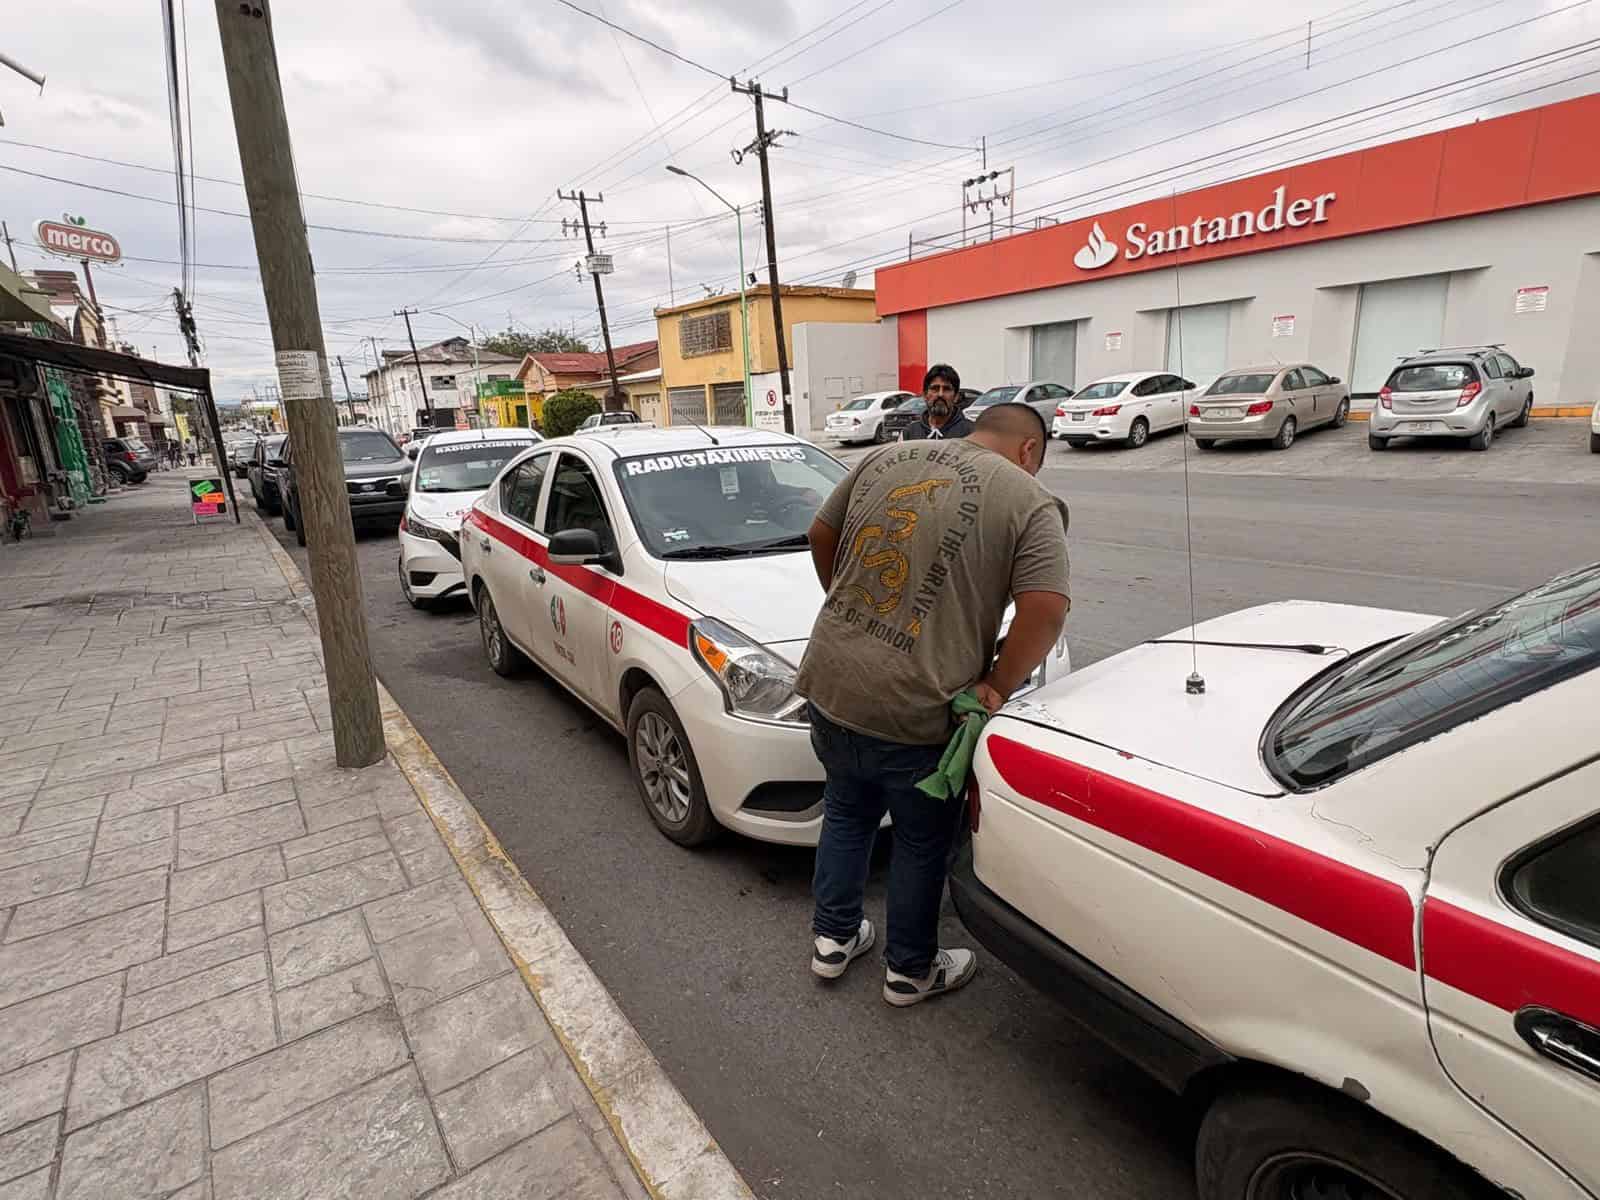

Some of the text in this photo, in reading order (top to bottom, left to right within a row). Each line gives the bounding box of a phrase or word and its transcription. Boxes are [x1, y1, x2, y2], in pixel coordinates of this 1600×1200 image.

[1124, 184, 1336, 261] Santander
[47, 228, 114, 256] merco
[874, 448, 919, 475] FREE
[926, 449, 982, 495] BECAUSE
[957, 501, 978, 527] OF
[937, 527, 968, 562] THE
[911, 562, 949, 620] BRAVE
[611, 624, 623, 650] 18
[845, 607, 865, 625] OF
[865, 617, 916, 653] HONOR
